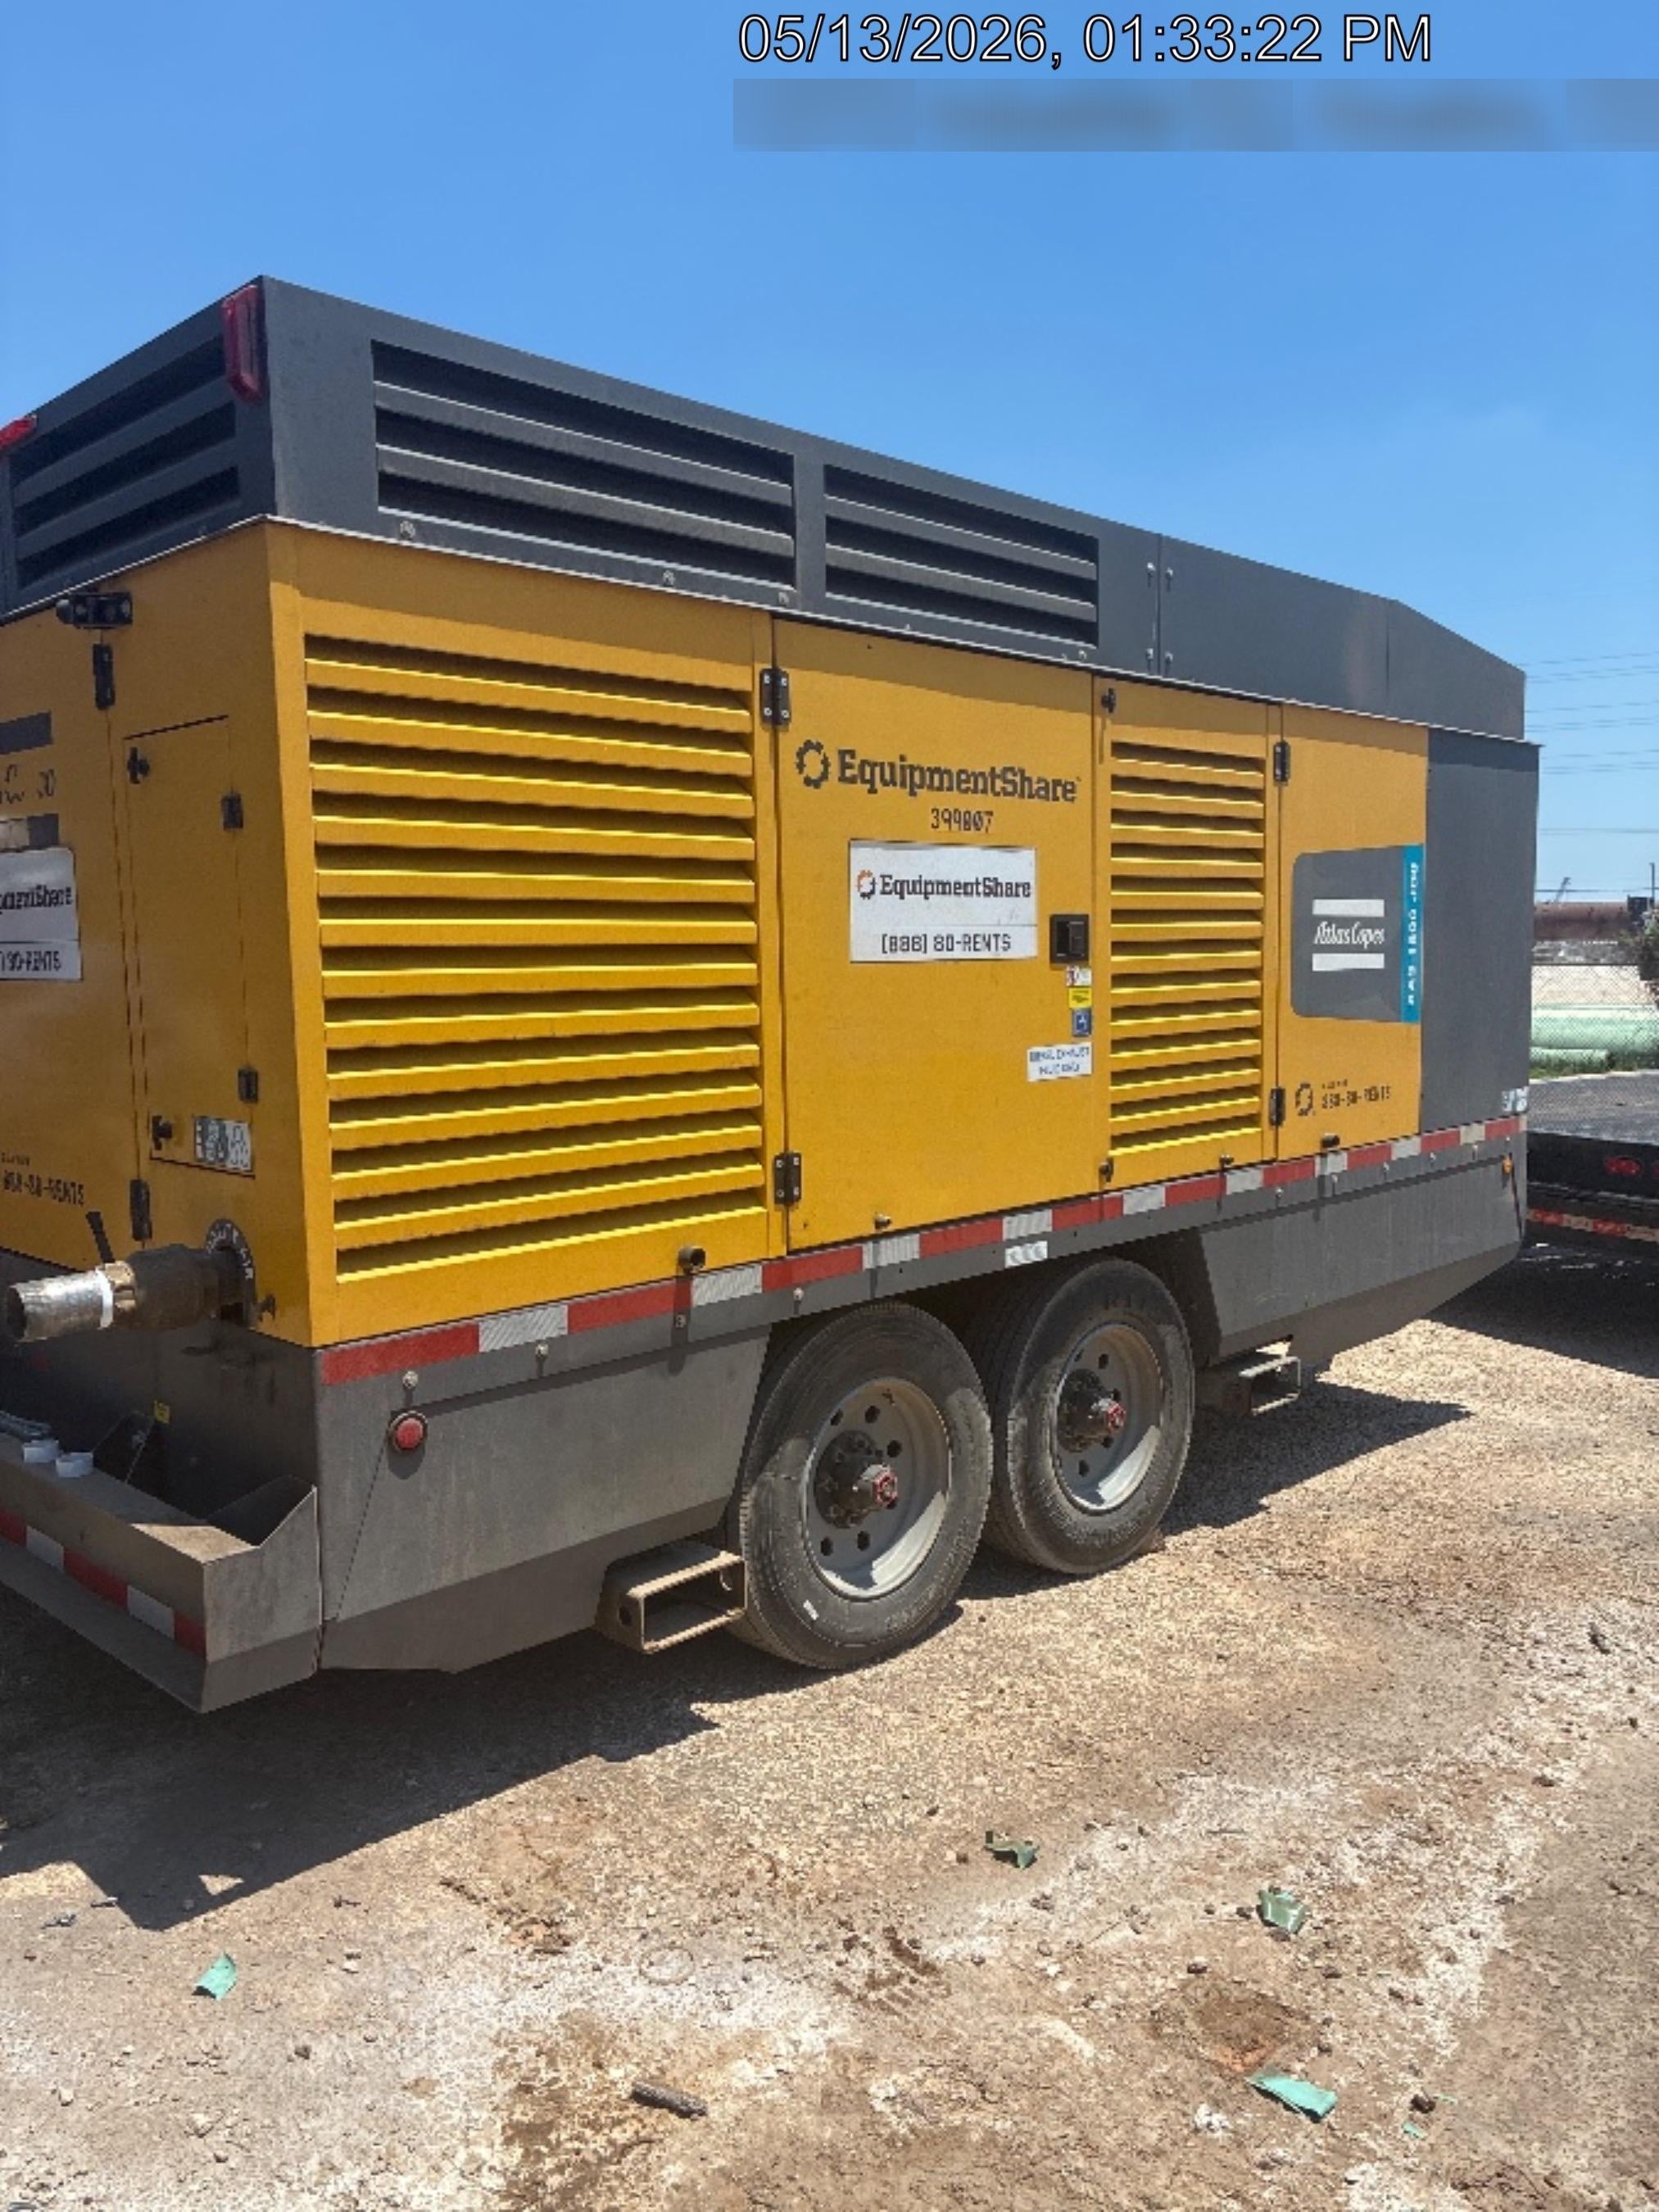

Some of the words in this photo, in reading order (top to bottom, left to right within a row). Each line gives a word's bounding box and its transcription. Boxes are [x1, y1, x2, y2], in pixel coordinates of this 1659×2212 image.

[837, 748, 1079, 803] EquipmentShare
[879, 874, 1031, 900] EquipmentShare
[933, 933, 1012, 953] 80-RENTS
